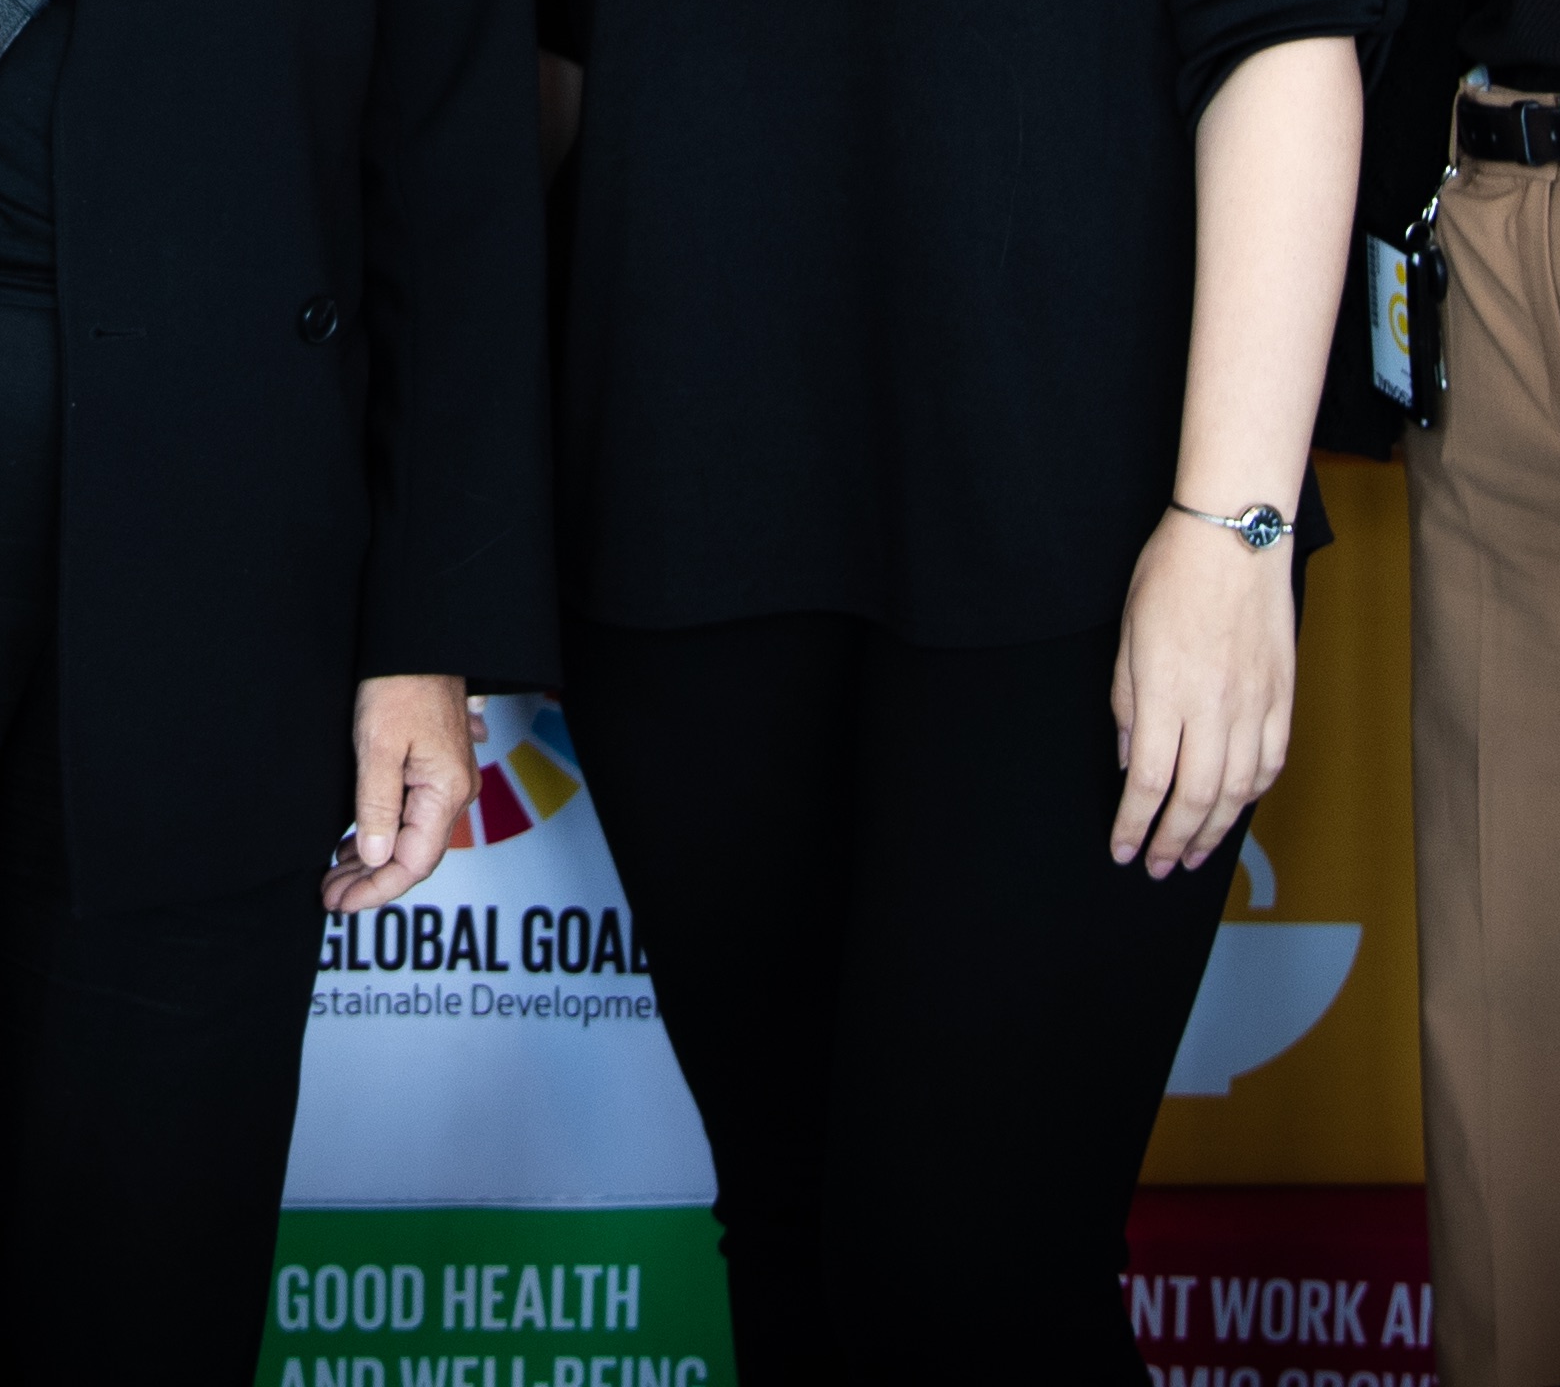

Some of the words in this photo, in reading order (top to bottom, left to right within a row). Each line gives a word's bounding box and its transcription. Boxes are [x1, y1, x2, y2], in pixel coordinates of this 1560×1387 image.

[318, 904, 509, 972] GLOBAL
[276, 1263, 425, 1331] GOOD
[442, 1263, 640, 1331] HEALTH
[1118, 1273, 1198, 1340] NT
[1210, 1276, 1368, 1344] WORK
